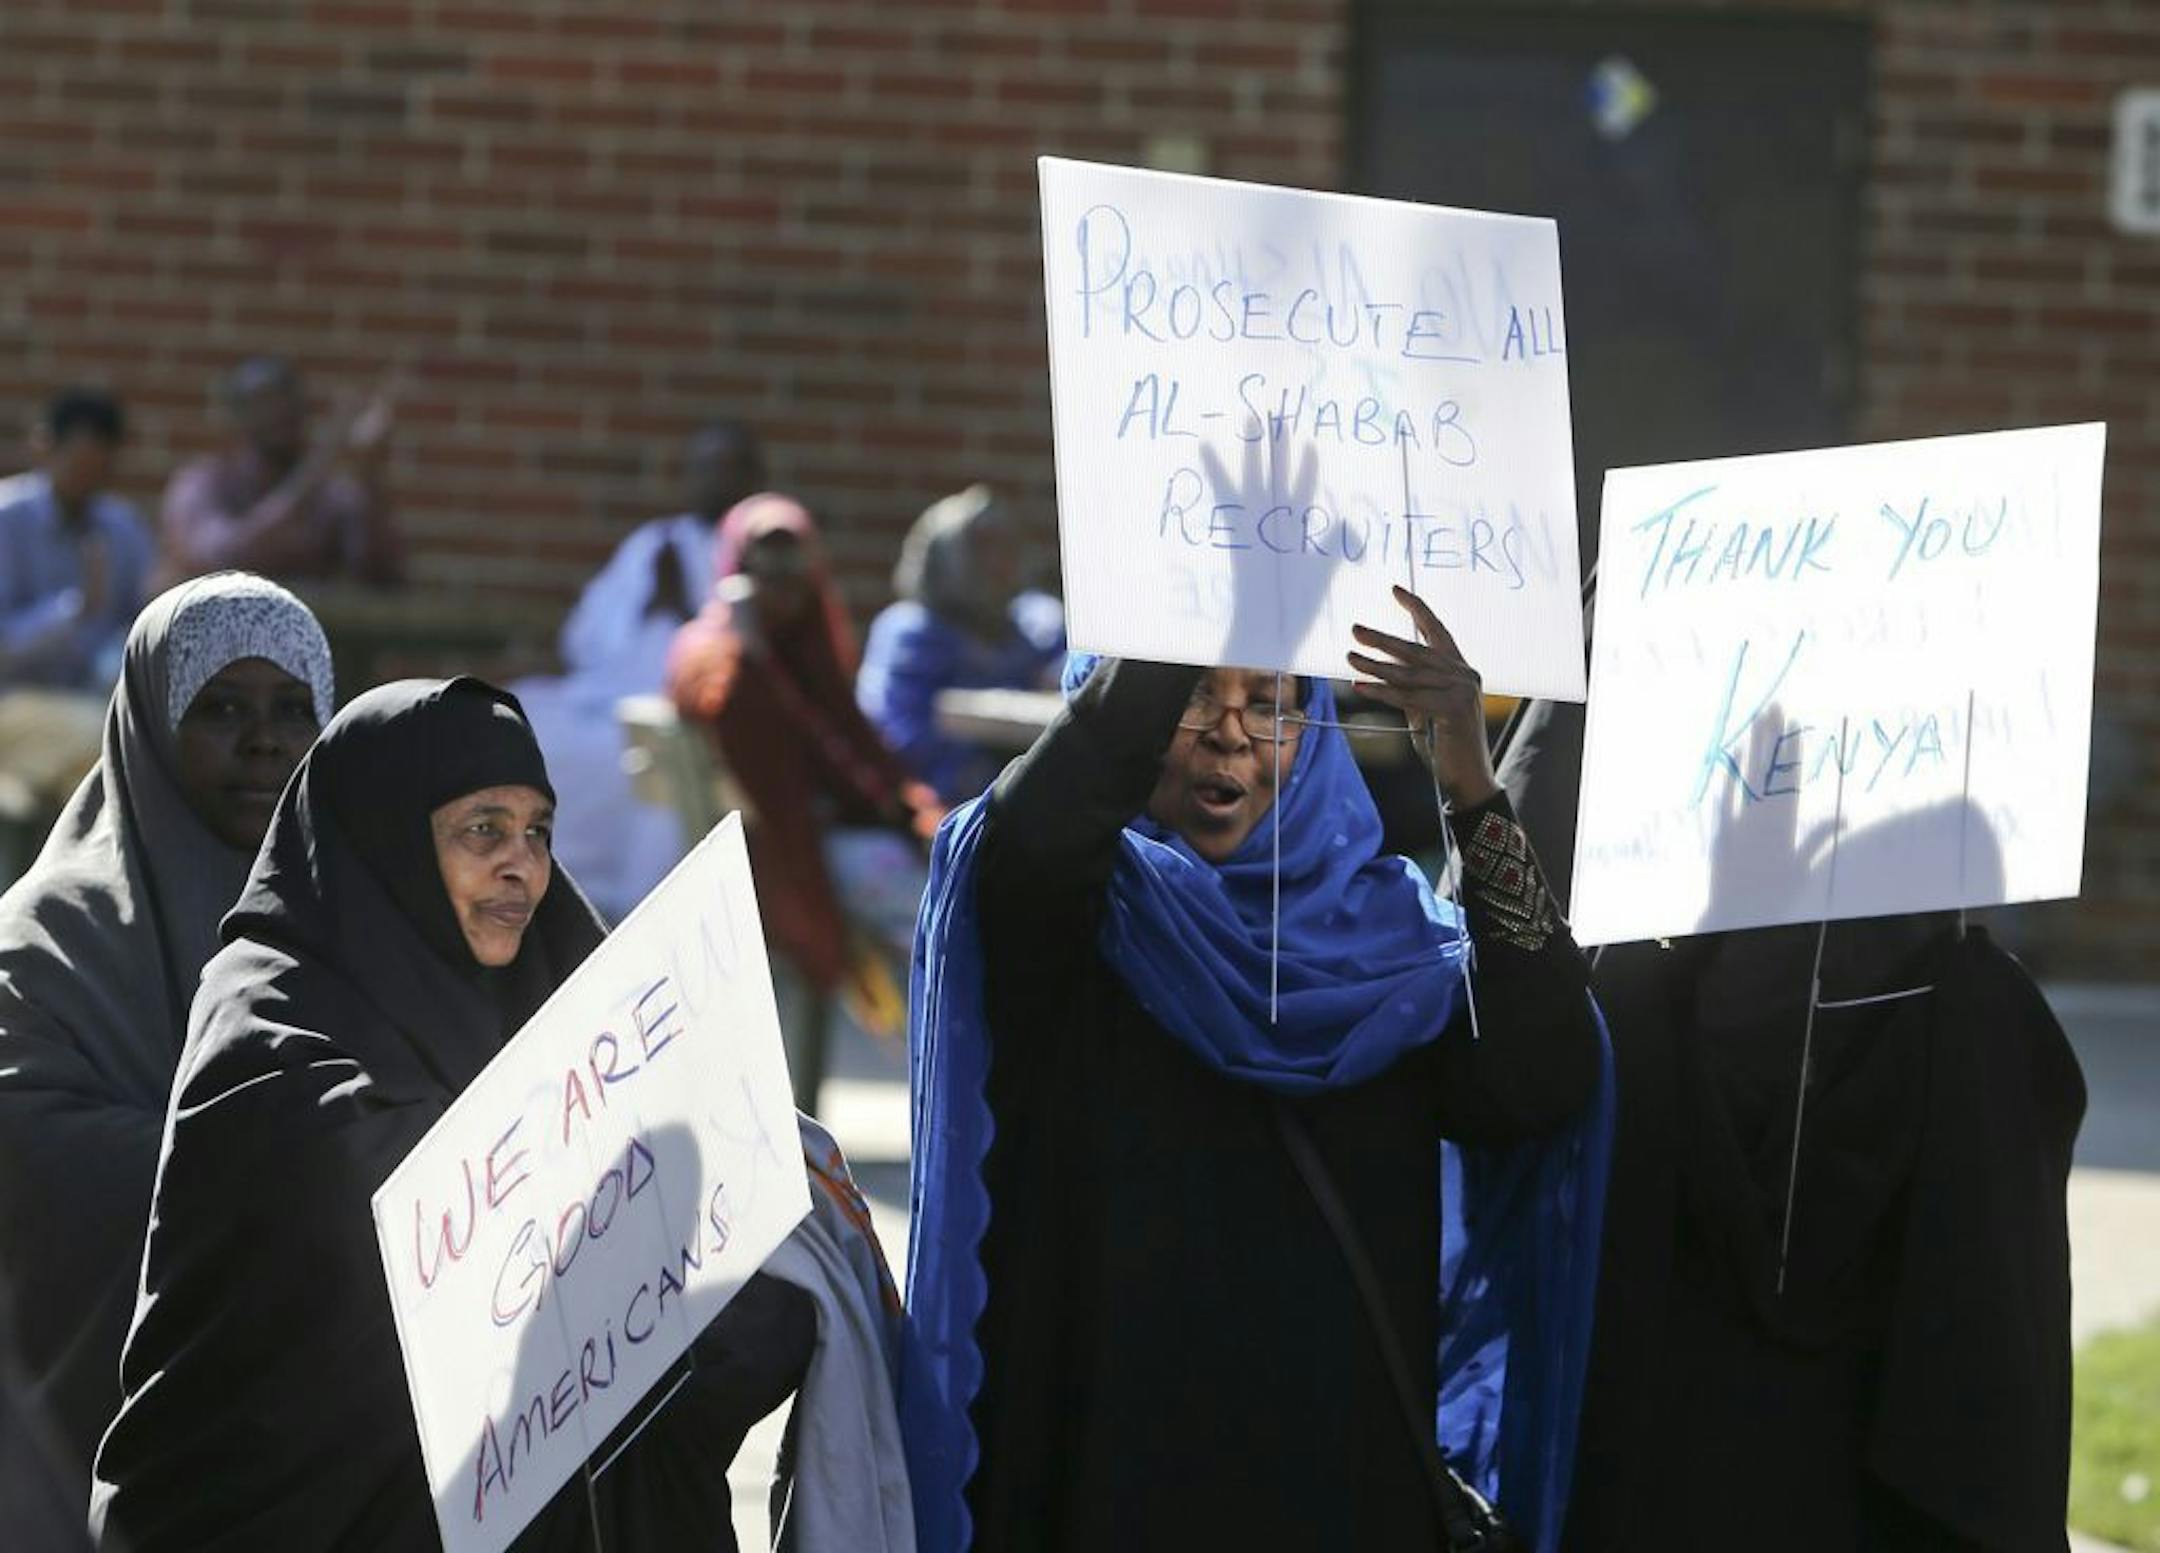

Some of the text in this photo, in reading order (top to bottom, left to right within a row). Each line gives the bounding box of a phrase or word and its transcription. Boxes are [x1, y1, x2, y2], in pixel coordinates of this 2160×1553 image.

[1076, 204, 1564, 362] PROSECUTE ALL
[1117, 373, 1476, 467] AL-SHABAB
[1632, 485, 2007, 600] THANK YOU
[1689, 629, 1948, 811] KENYA
[413, 975, 685, 1290] WE ARE
[491, 1134, 655, 1328] GOOD
